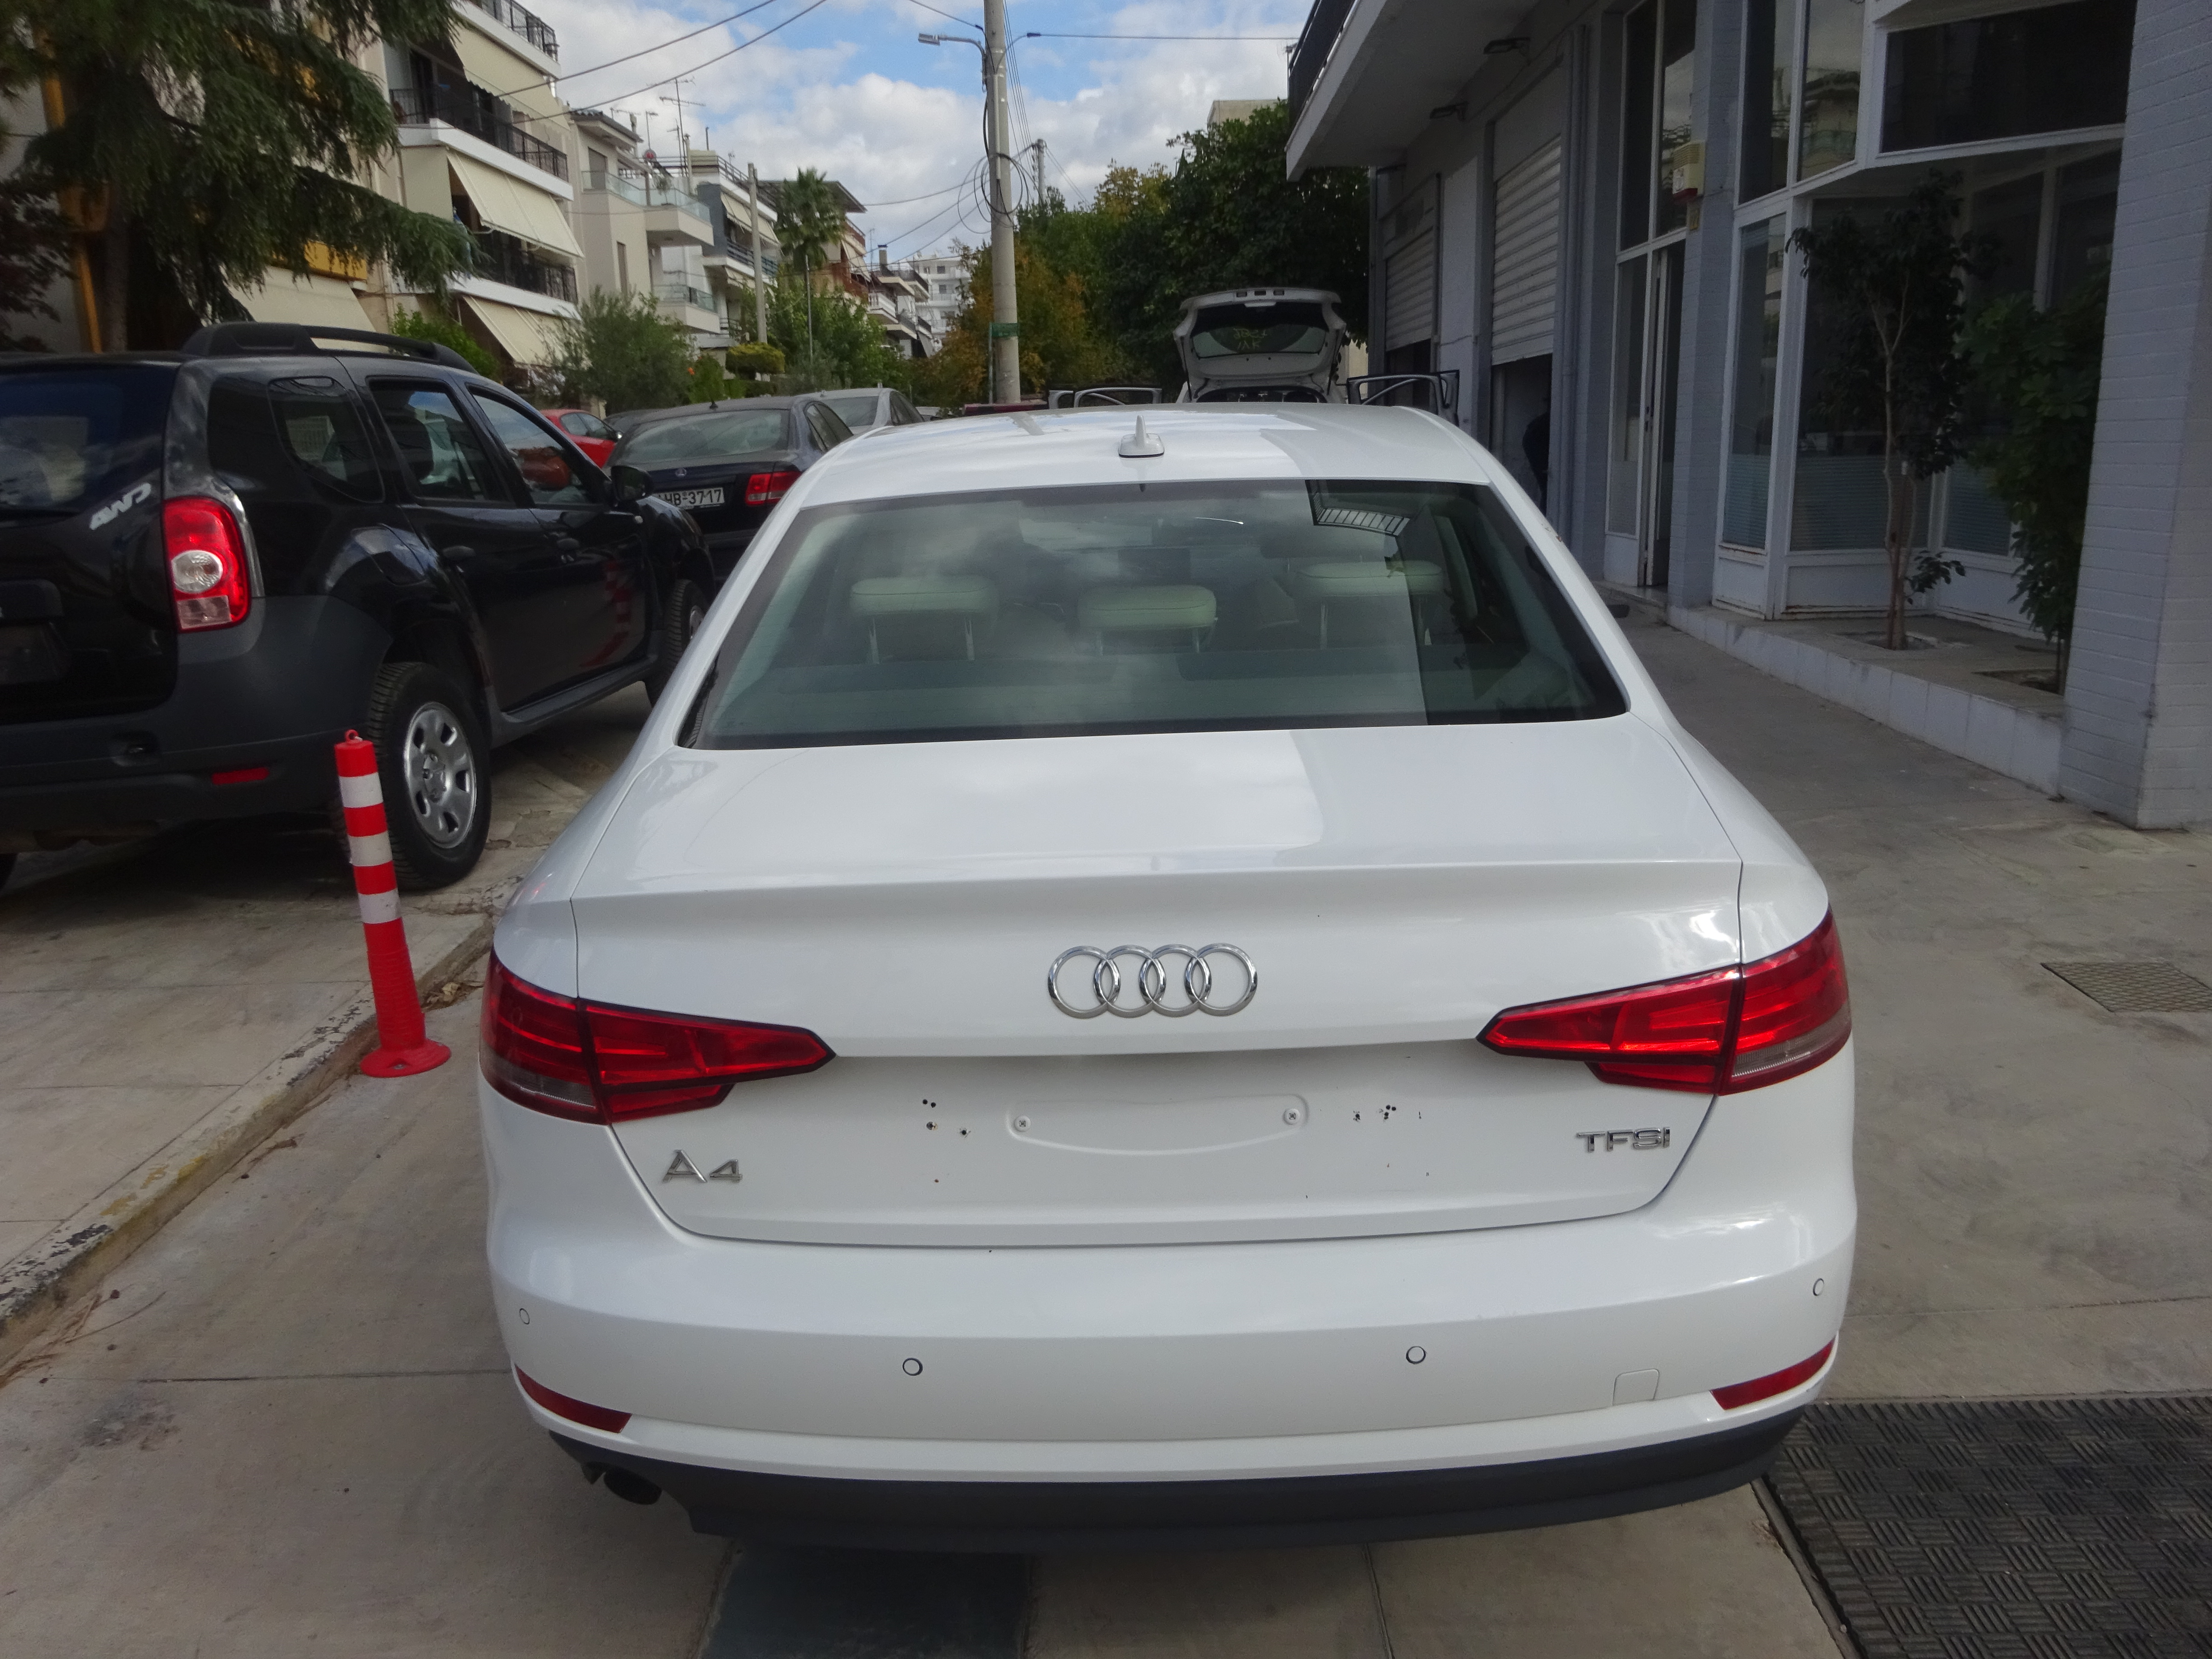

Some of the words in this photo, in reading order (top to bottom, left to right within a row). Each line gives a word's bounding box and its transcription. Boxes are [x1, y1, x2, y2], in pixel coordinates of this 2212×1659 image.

[89, 483, 151, 530] 4WD
[658, 489, 722, 506] HB-3717
[1576, 1127, 1670, 1152] TFSI
[662, 1149, 743, 1183] A4
